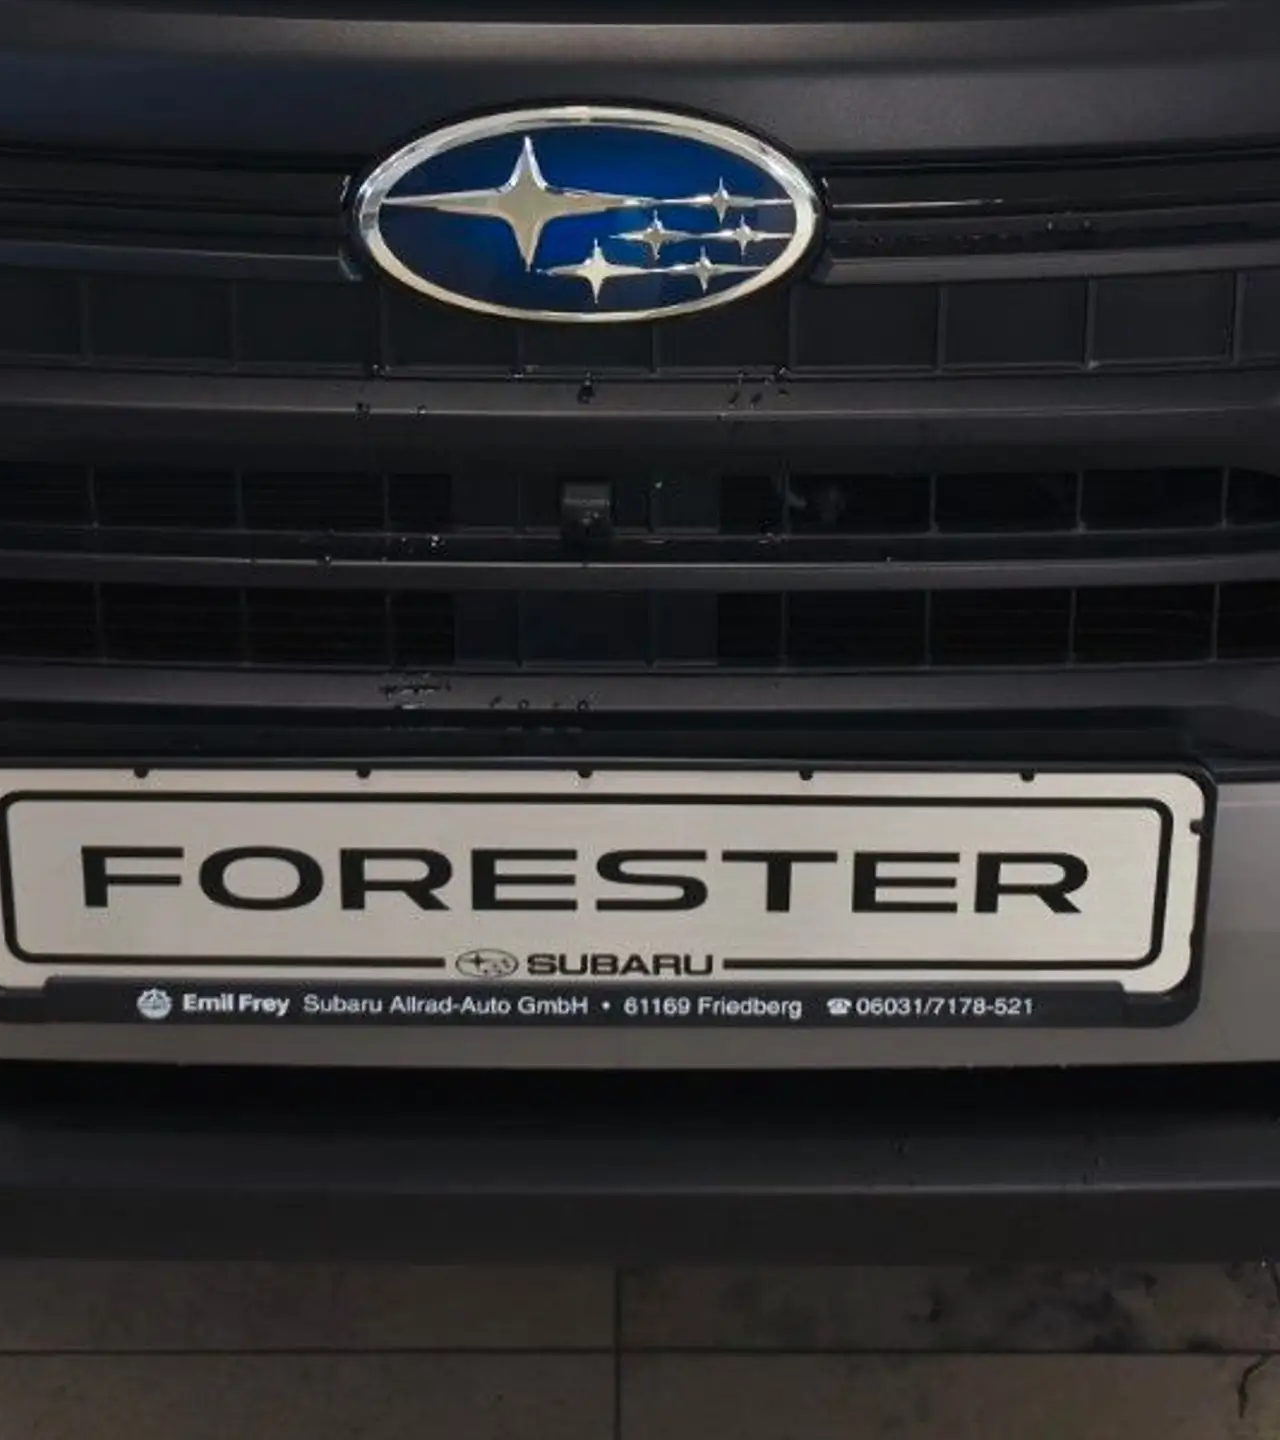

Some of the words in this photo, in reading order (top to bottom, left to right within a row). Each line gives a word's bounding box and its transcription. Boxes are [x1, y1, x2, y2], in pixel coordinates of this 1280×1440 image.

[81, 846, 1089, 914] FORESTER
[527, 953, 714, 976] SUBARU
[183, 993, 234, 1012] Emil
[238, 993, 290, 1017] Frey
[303, 994, 383, 1013] Subaru
[390, 995, 512, 1014] Allrad-Auto
[517, 996, 589, 1015] GmbH
[623, 996, 691, 1015] 61169
[698, 996, 803, 1019] Friedberg
[855, 997, 1033, 1016] 06031/7178-521
